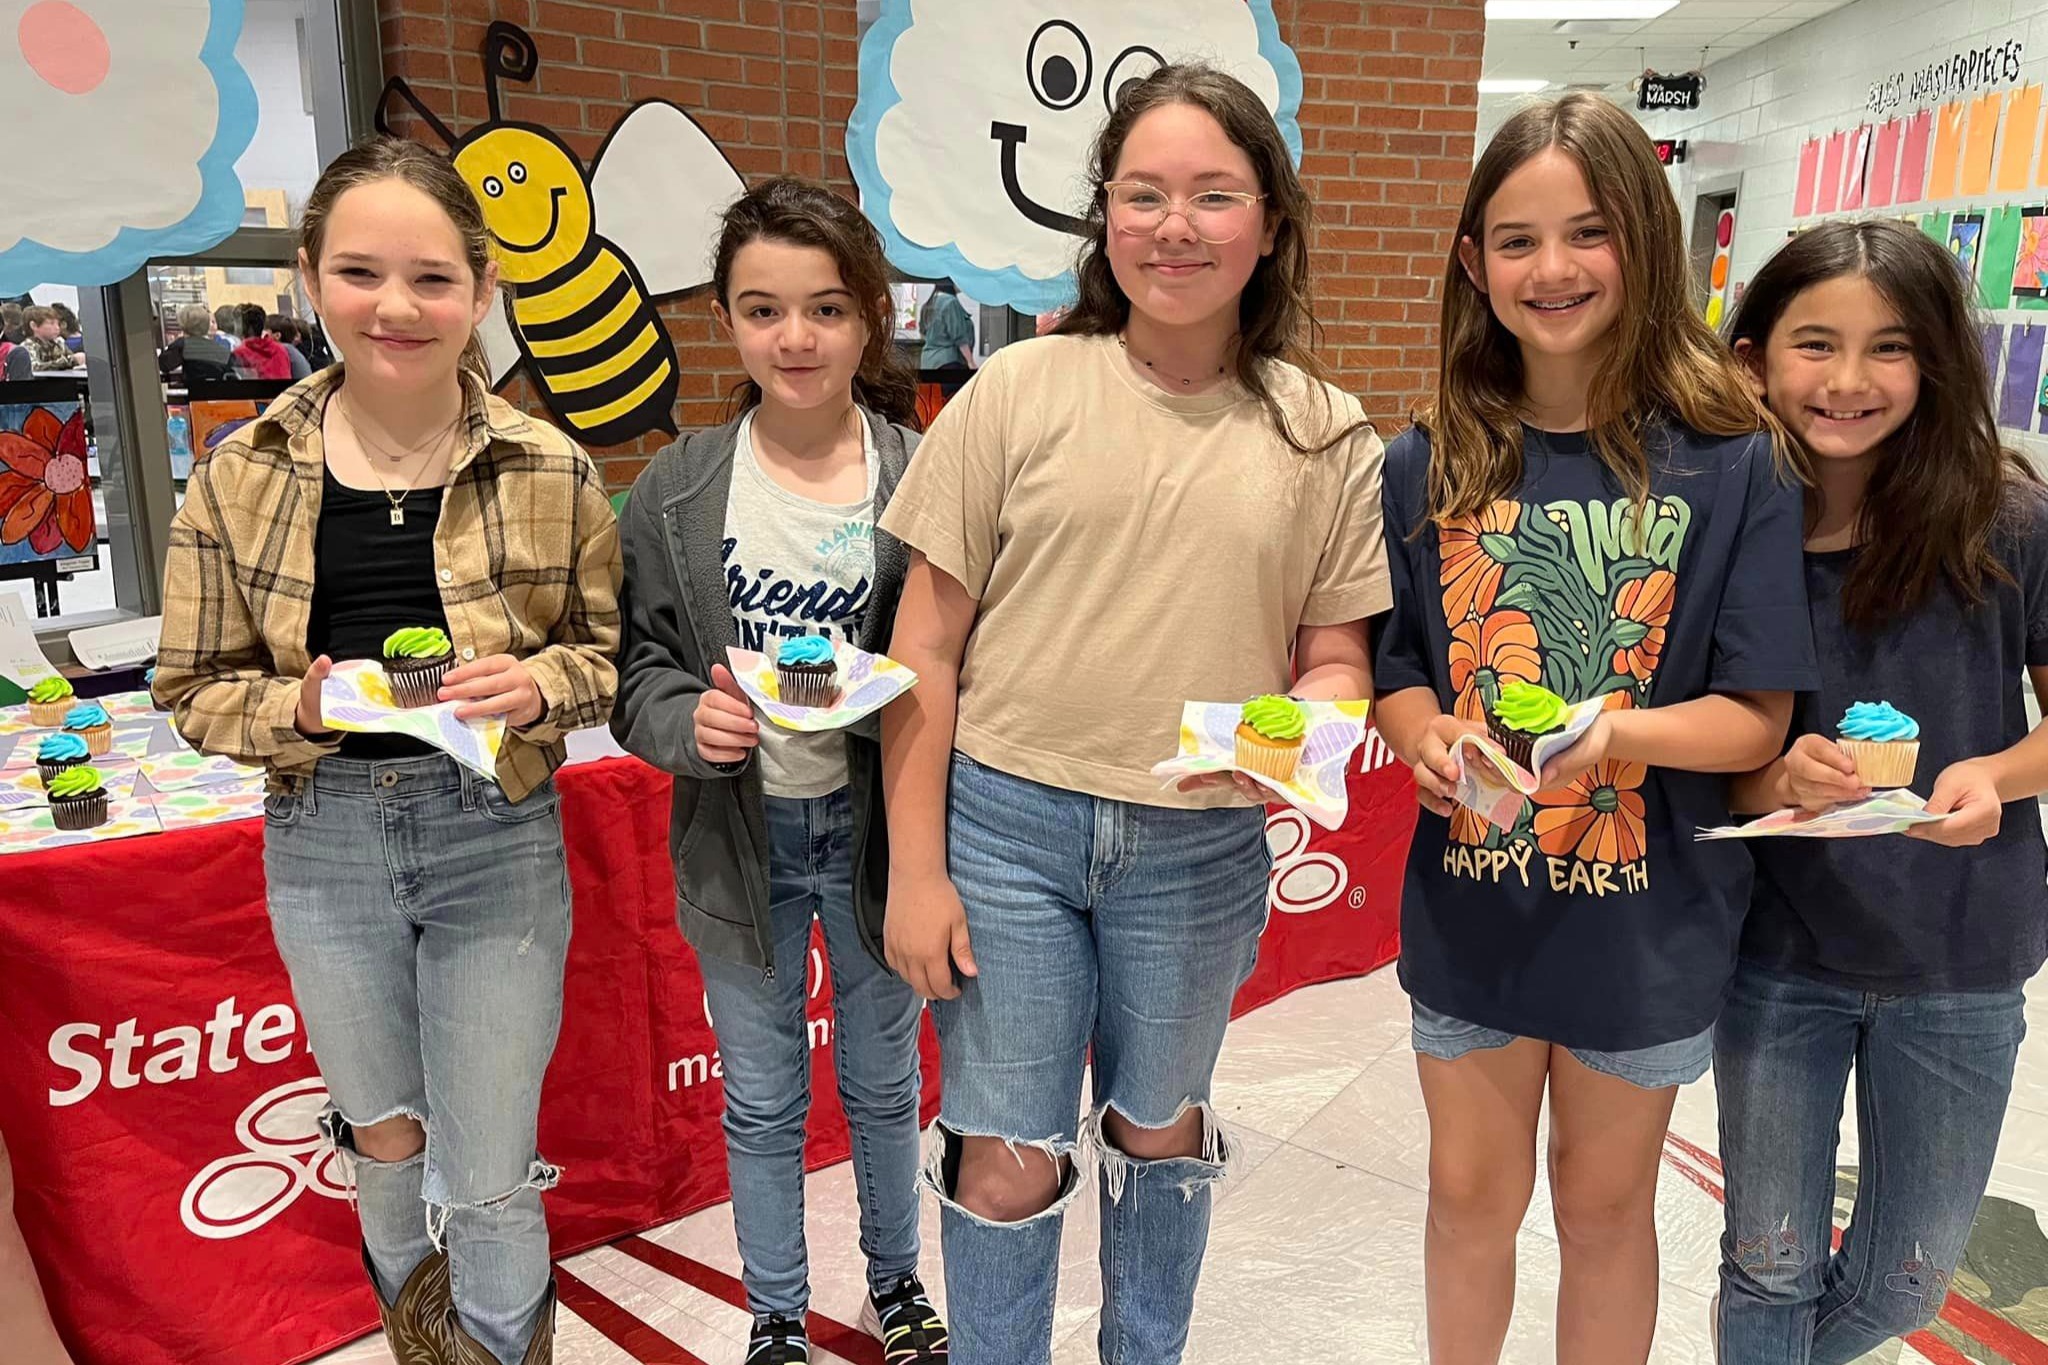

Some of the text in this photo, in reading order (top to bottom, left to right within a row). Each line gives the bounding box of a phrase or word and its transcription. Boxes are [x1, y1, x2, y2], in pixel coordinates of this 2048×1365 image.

[1646, 90, 1691, 105] MARSH
[1909, 38, 2022, 103] MASTERPIECES
[1443, 845, 1649, 898] HAPPY EARTH
[48, 995, 296, 1107] State
